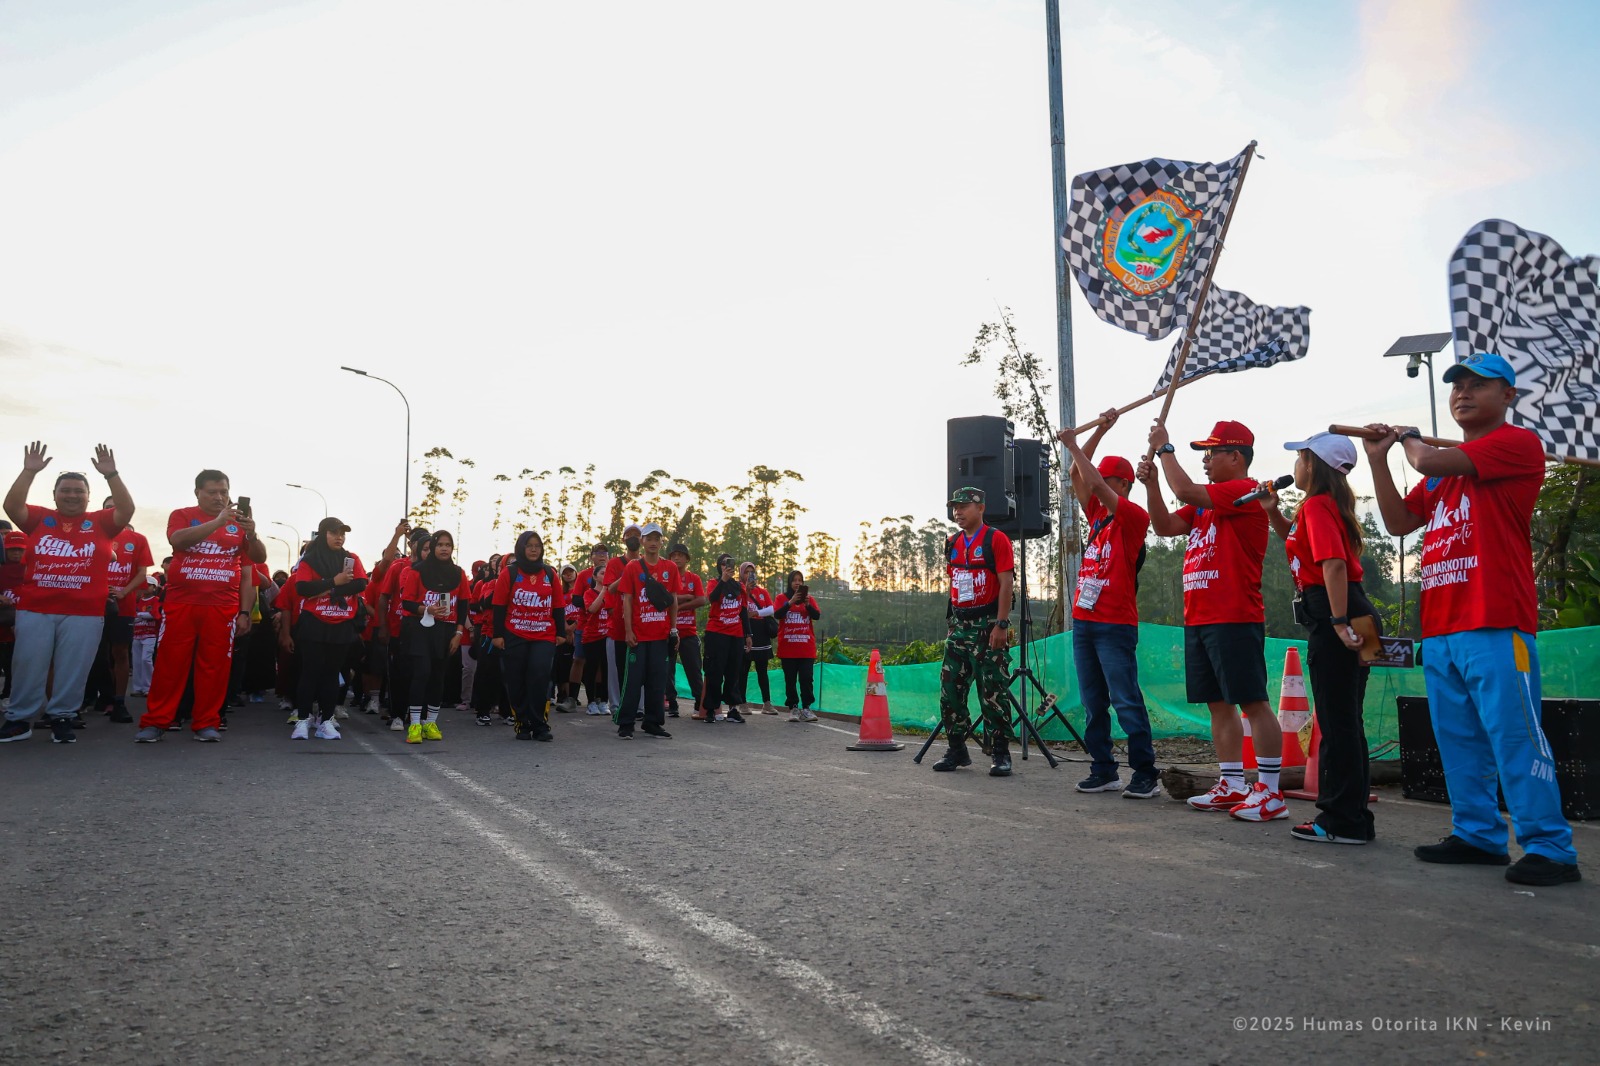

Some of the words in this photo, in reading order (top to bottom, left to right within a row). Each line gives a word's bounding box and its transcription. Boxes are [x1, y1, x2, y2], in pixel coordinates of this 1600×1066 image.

[38, 535, 66, 549] fun
[34, 543, 78, 558] walk
[1433, 556, 1478, 576] NARKOTIKA
[514, 588, 538, 600] fun
[512, 596, 544, 608] walk
[1530, 759, 1553, 783] BNN
